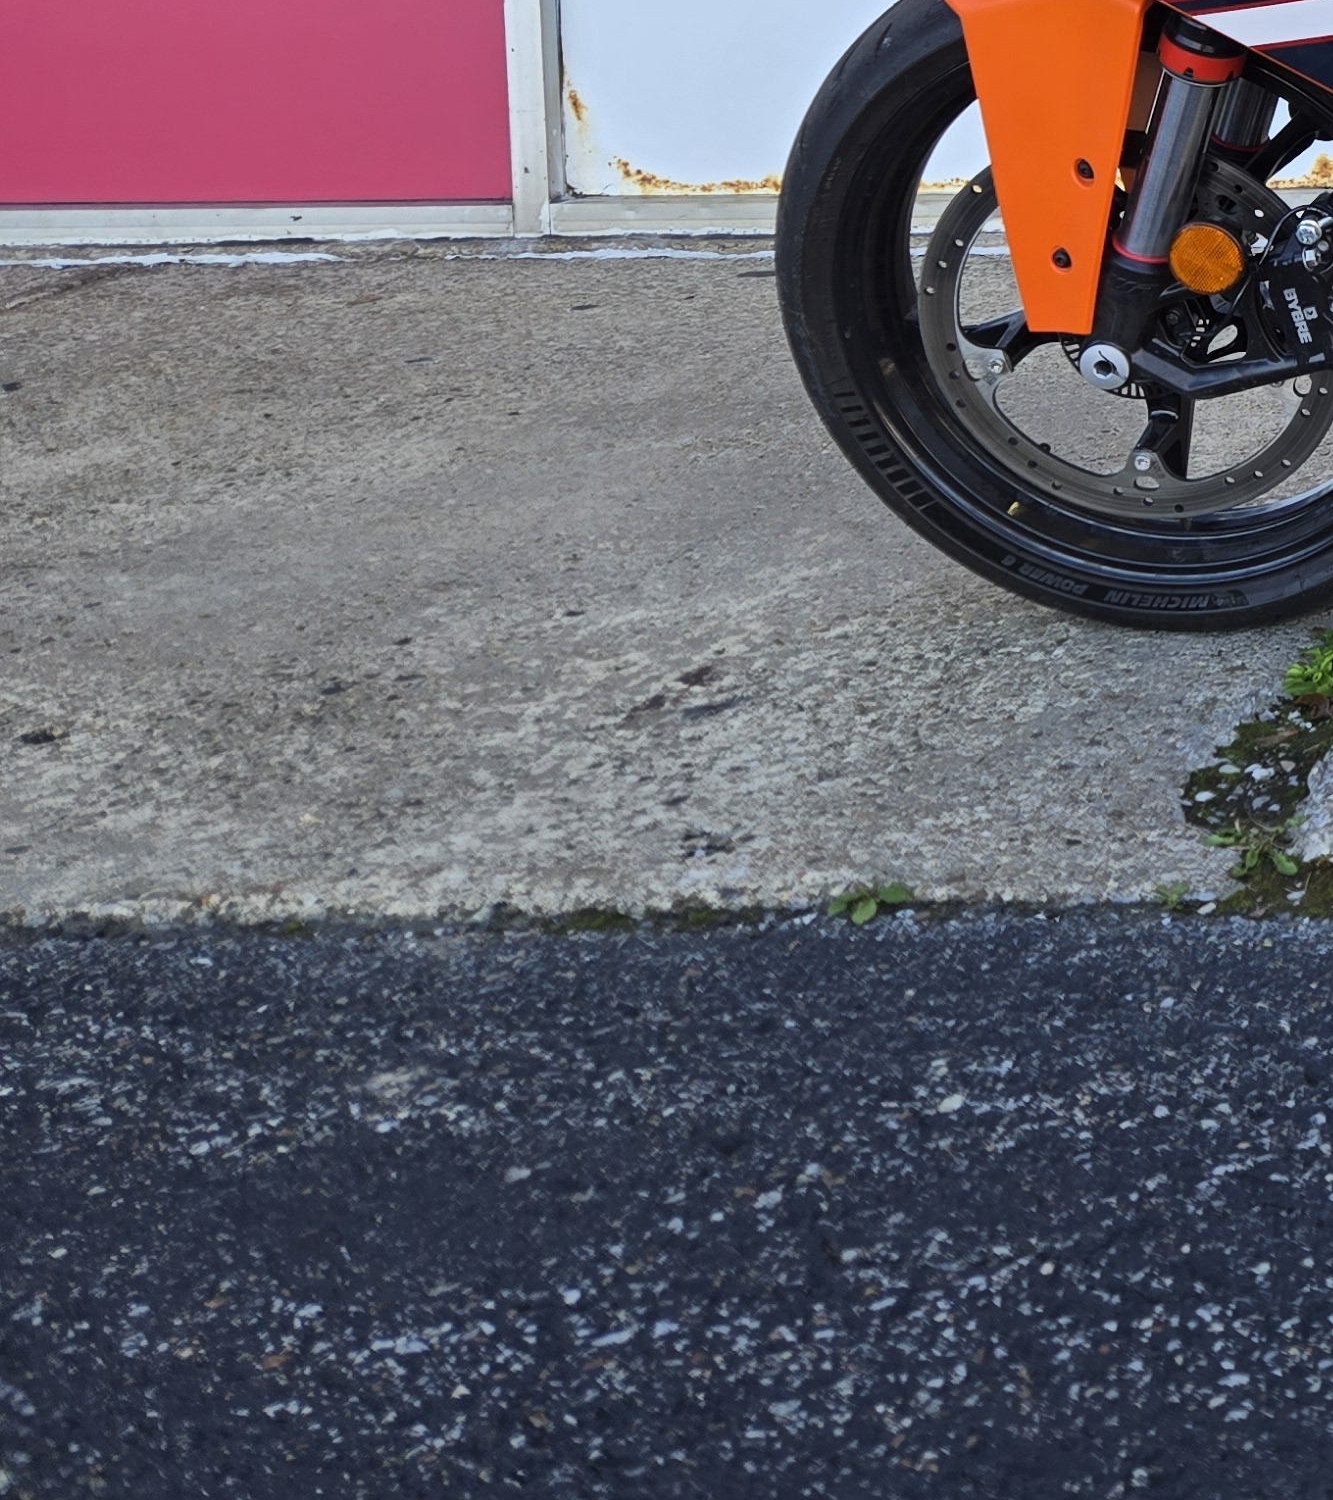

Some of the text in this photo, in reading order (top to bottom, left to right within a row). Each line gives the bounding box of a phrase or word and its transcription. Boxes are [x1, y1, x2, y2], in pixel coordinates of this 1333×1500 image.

[1283, 287, 1313, 344] BYBRE
[1018, 561, 1090, 596] POWER
[1104, 590, 1211, 609] MICHELIN
